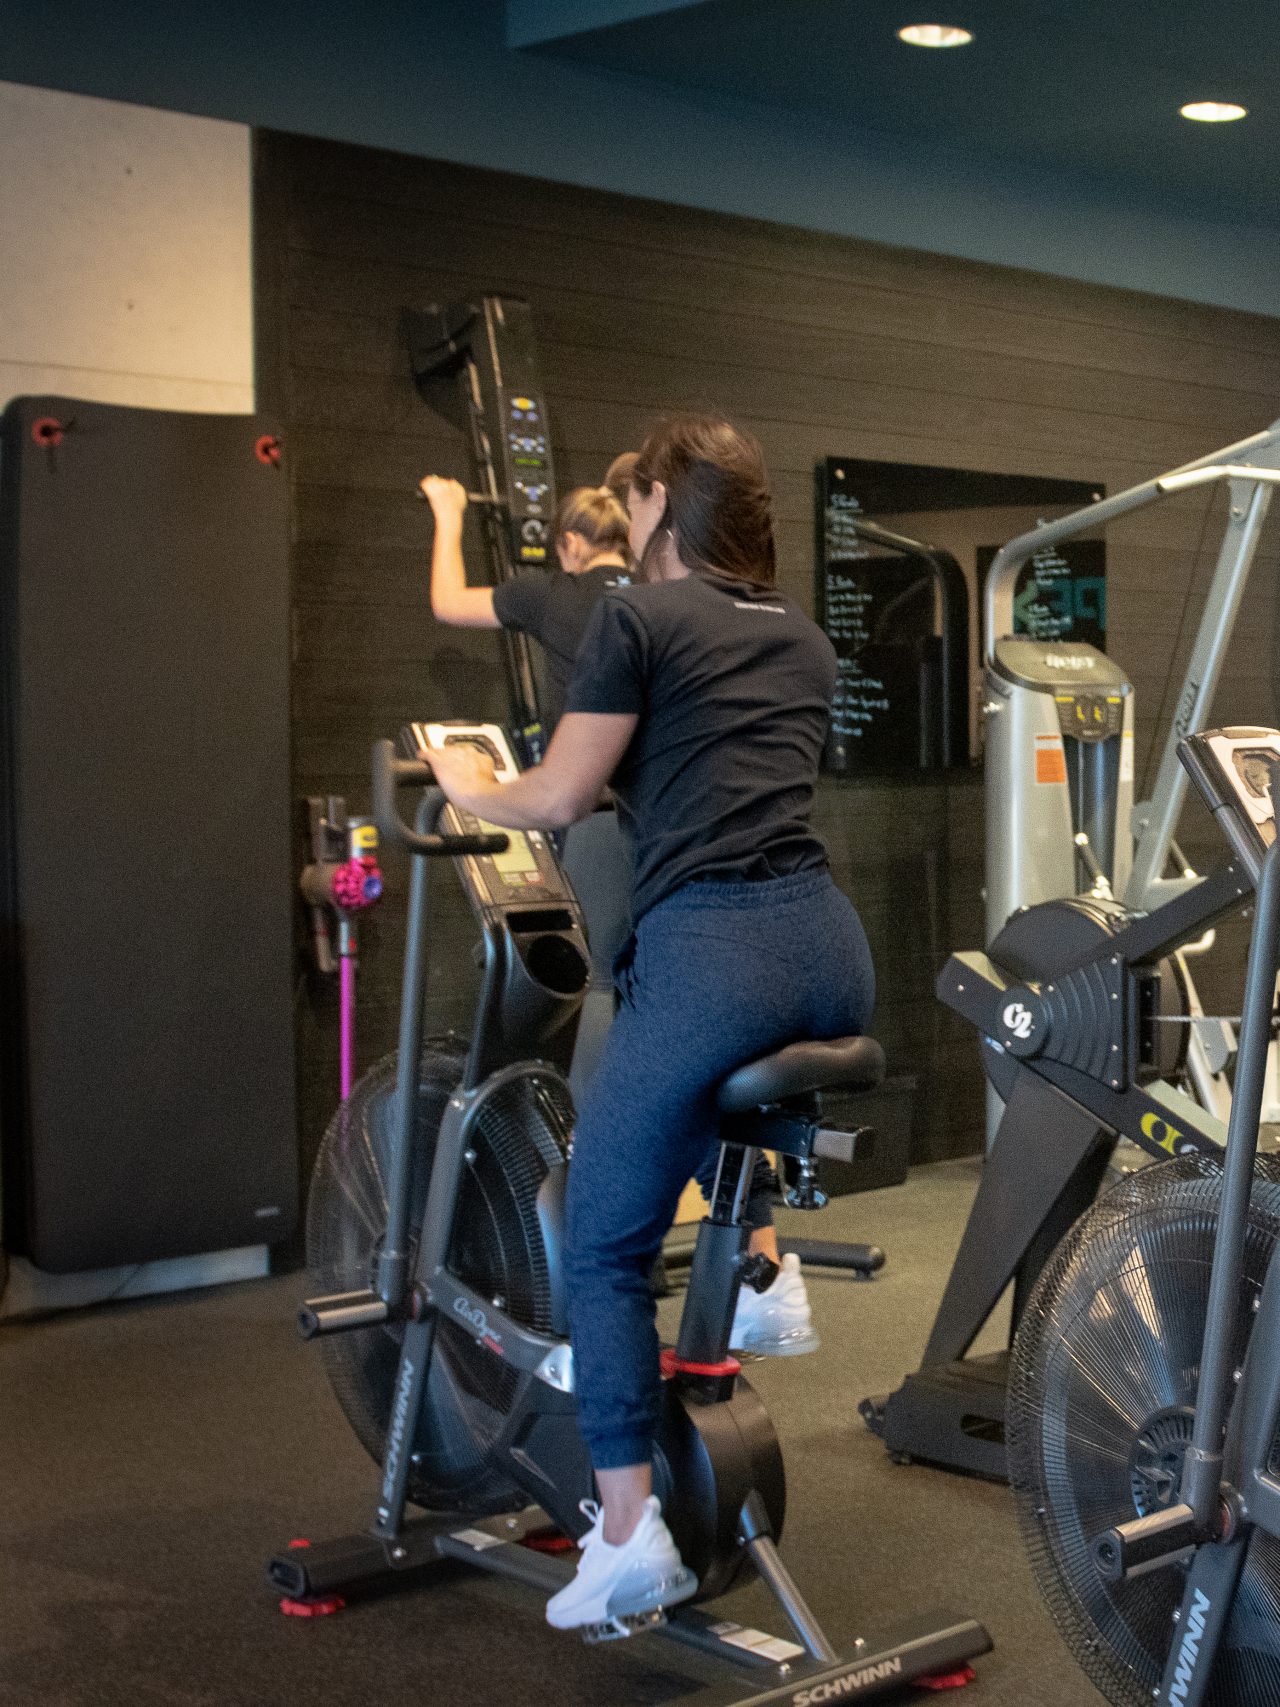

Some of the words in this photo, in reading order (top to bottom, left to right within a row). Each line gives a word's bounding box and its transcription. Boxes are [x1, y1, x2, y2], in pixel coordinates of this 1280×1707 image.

[382, 1357, 415, 1504] SCHWINN
[791, 1656, 903, 1707] SCHWINN
[1168, 1587, 1211, 1707] WINN
